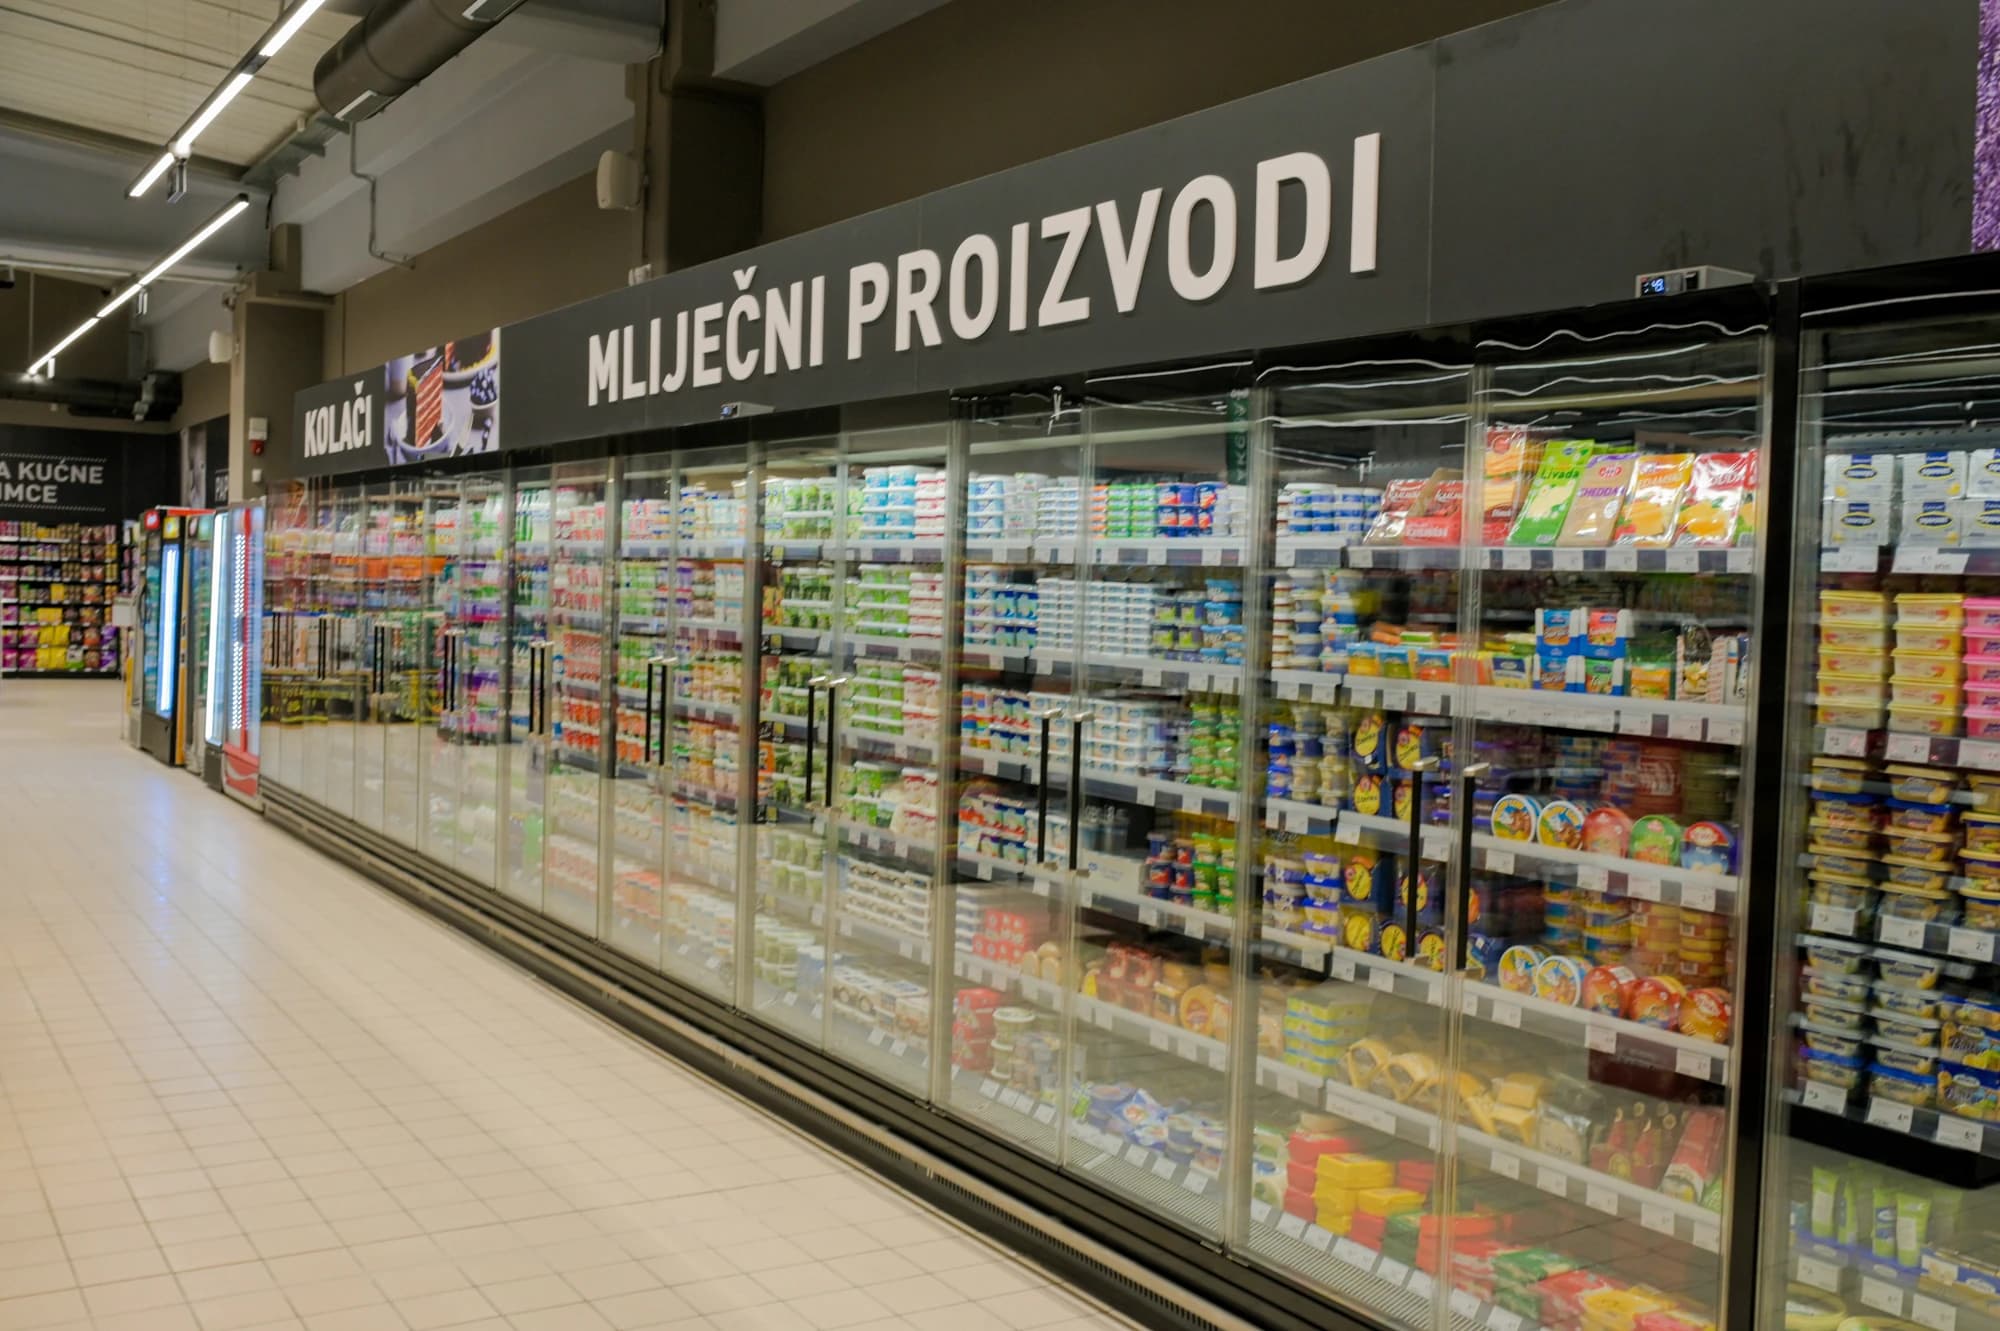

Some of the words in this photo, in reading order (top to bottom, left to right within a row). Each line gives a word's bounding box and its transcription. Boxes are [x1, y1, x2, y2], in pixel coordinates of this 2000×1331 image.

[588, 265, 826, 407] MLIJEČNI
[847, 132, 1381, 360] PROIZVODI
[303, 379, 372, 458] KOLAČI
[18, 458, 104, 485] KUĆNE
[1541, 468, 1580, 479] Livada
[1577, 486, 1626, 498] HEDDA
